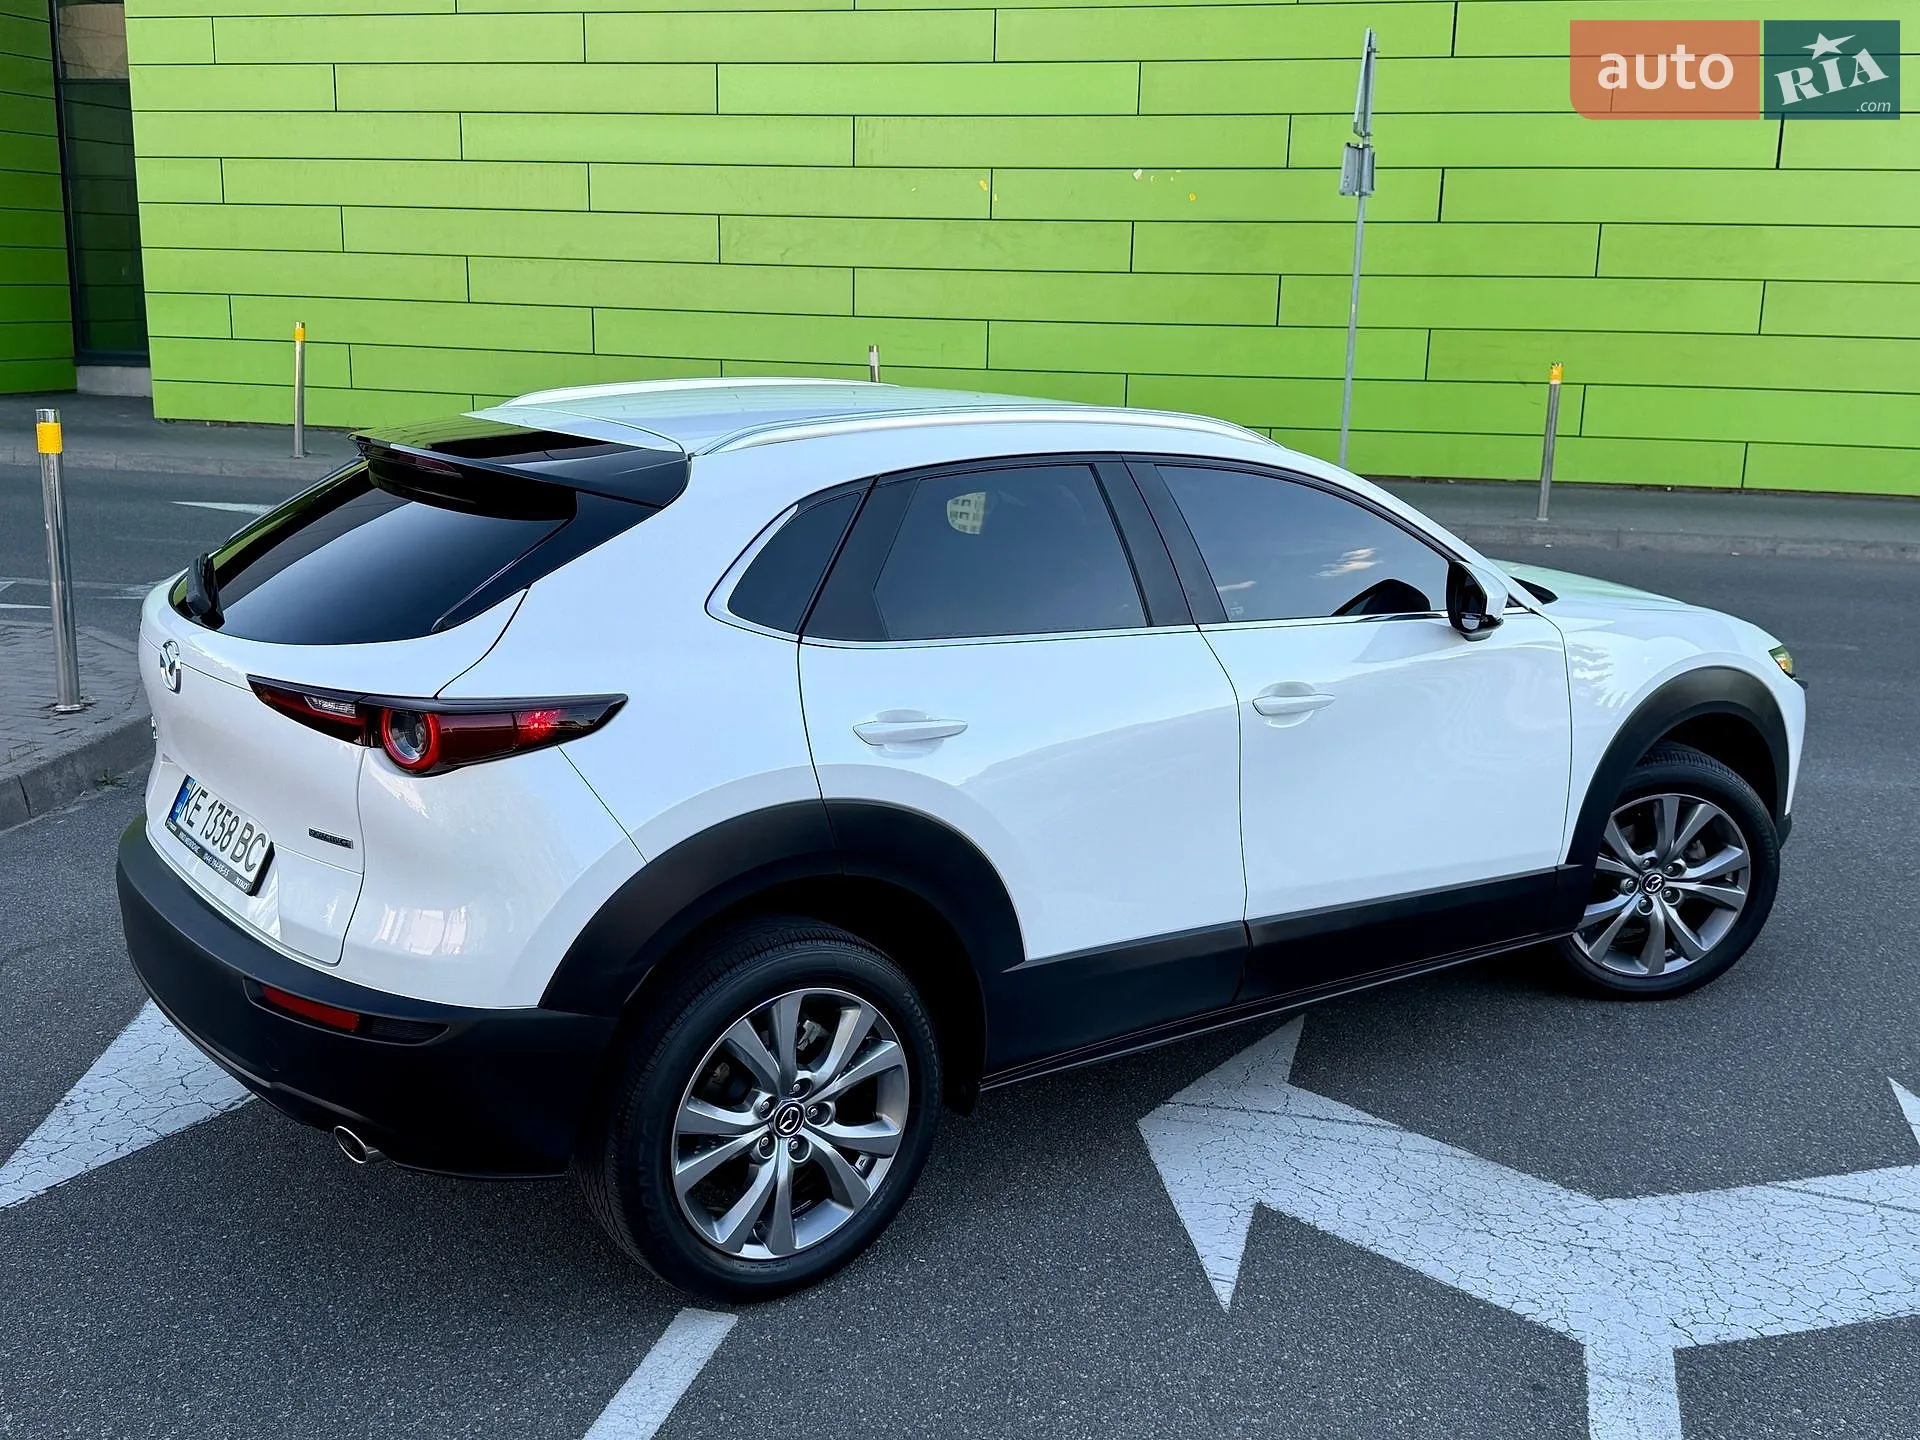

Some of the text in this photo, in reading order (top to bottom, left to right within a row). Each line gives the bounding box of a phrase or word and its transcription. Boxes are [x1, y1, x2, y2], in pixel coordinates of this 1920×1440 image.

[179, 782, 208, 828] KE
[200, 800, 239, 852] 1358
[230, 822, 266, 872] BC
